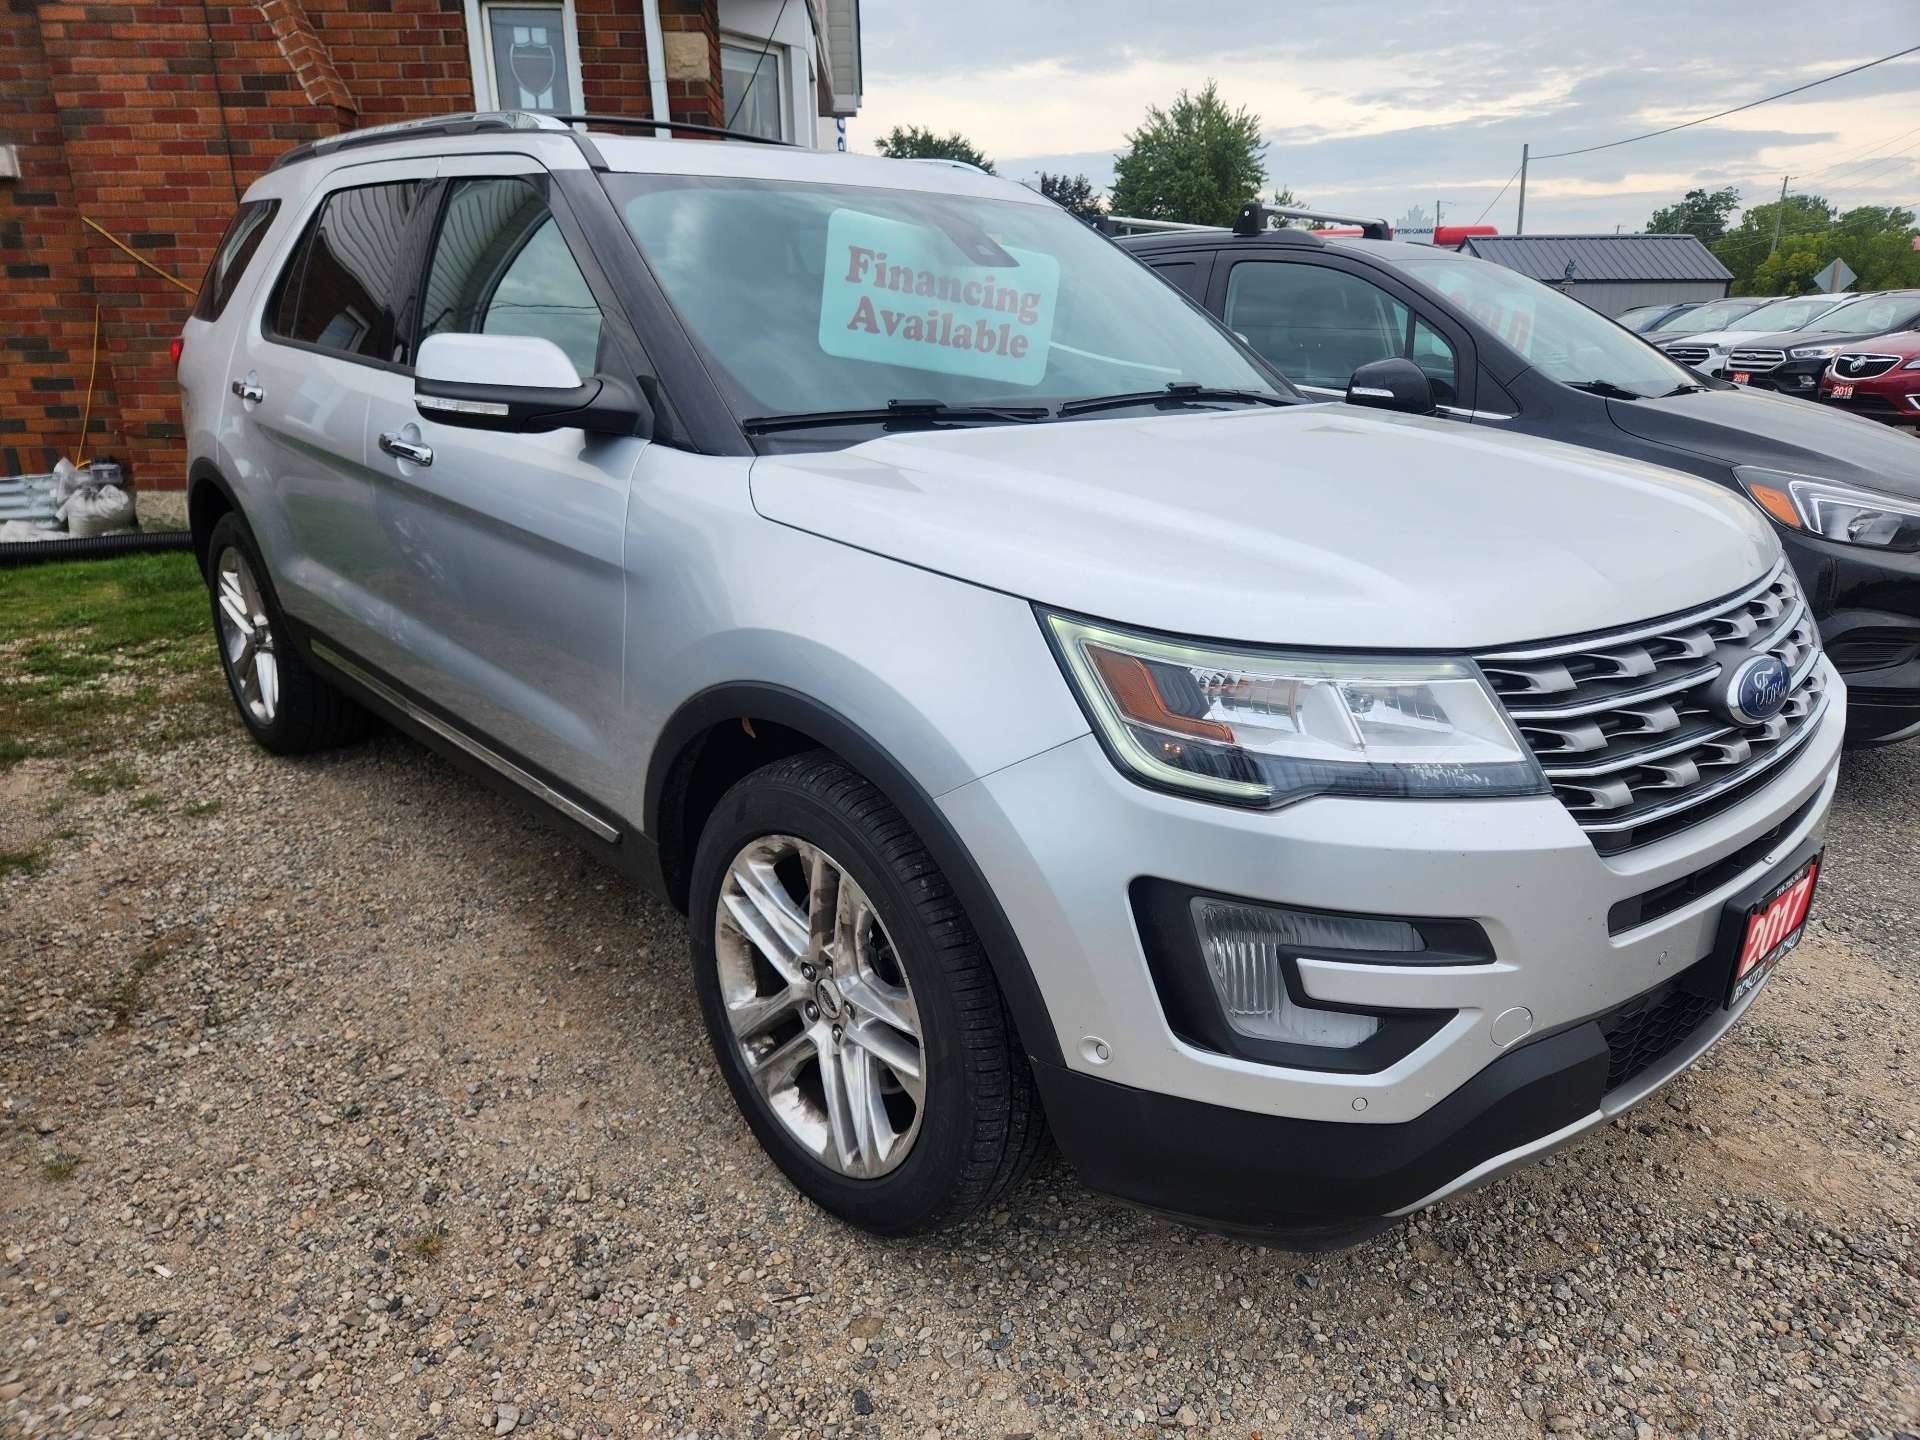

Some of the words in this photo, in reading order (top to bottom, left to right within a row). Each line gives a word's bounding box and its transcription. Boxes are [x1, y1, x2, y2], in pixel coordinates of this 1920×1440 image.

[844, 245, 1041, 326] Financing
[846, 295, 1029, 359] Available
[1833, 385, 1853, 396] 2019
[1753, 666, 1788, 710] Ford
[1740, 875, 1811, 978] 2017
